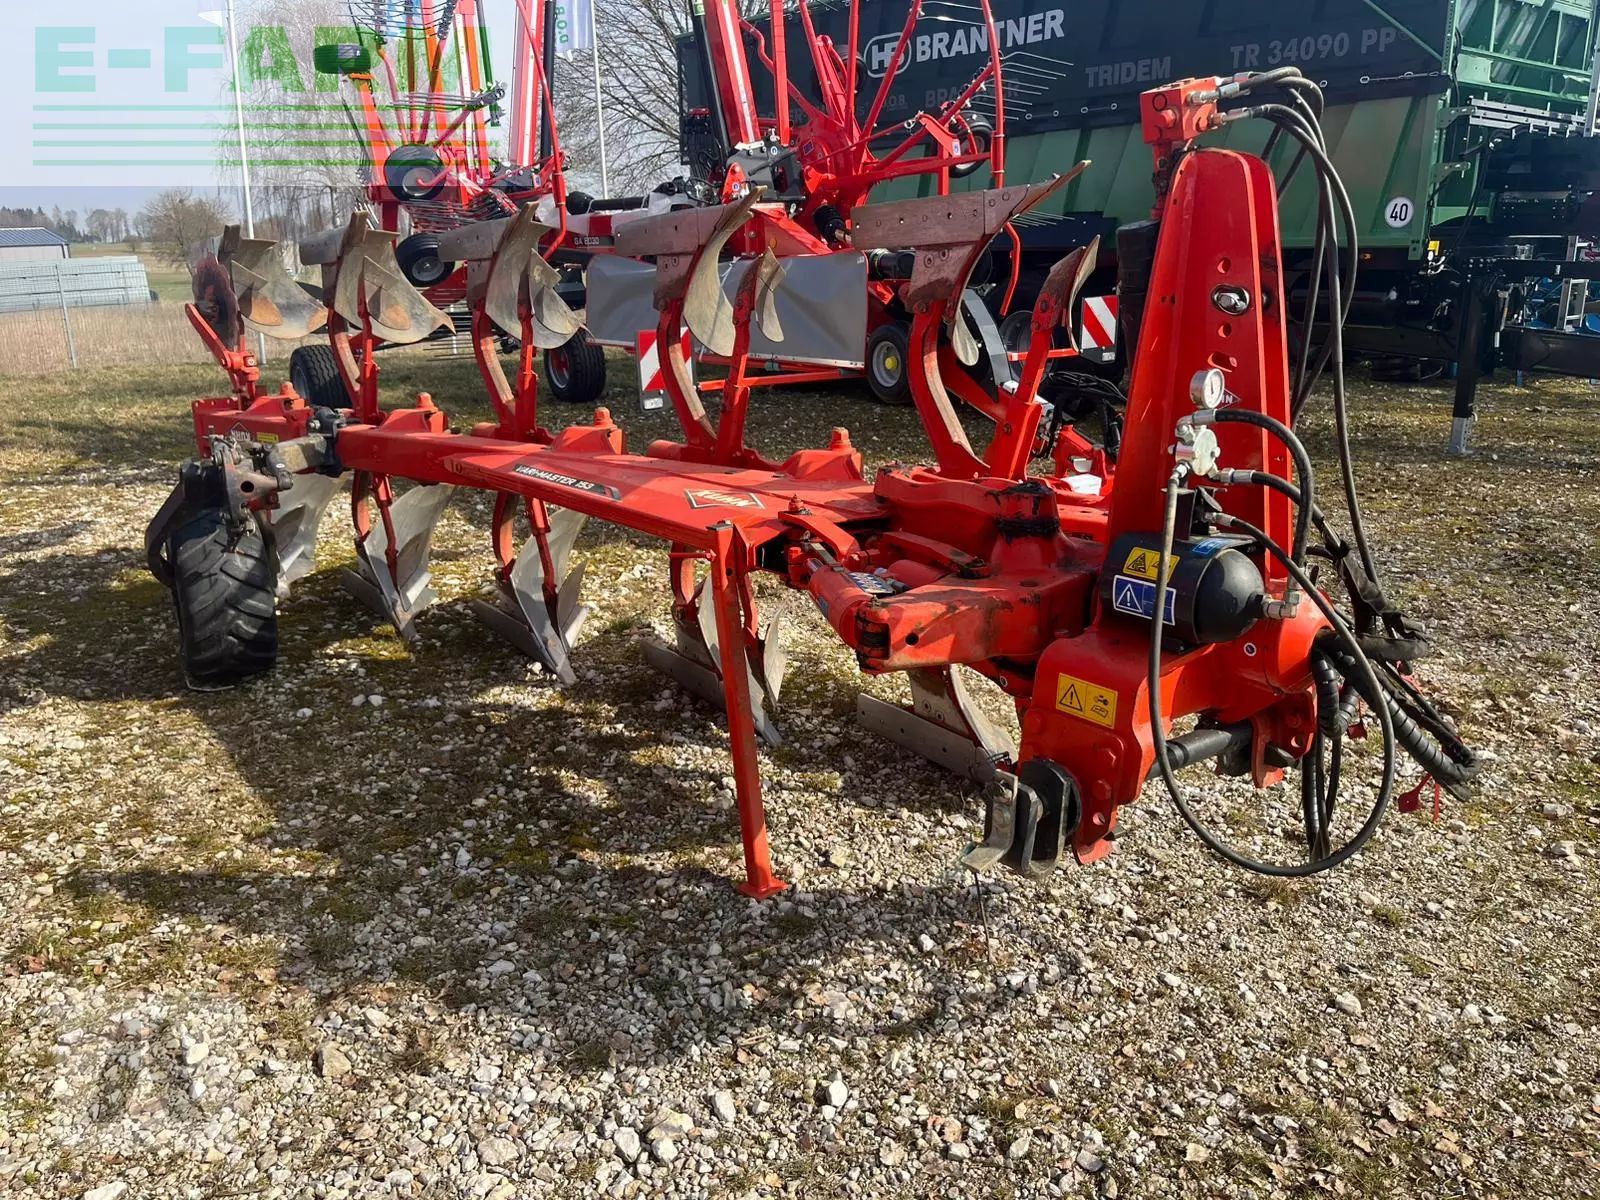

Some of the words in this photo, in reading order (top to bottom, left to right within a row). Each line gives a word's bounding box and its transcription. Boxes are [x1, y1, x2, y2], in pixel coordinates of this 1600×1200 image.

[916, 9, 1065, 63] BRANTNER
[1230, 44, 1259, 69] TR
[1267, 32, 1350, 65] 34090
[1085, 56, 1171, 88] TRIDEM
[1390, 203, 1408, 221] 40
[516, 464, 577, 486] VARI-MASTER
[575, 480, 595, 490] 153
